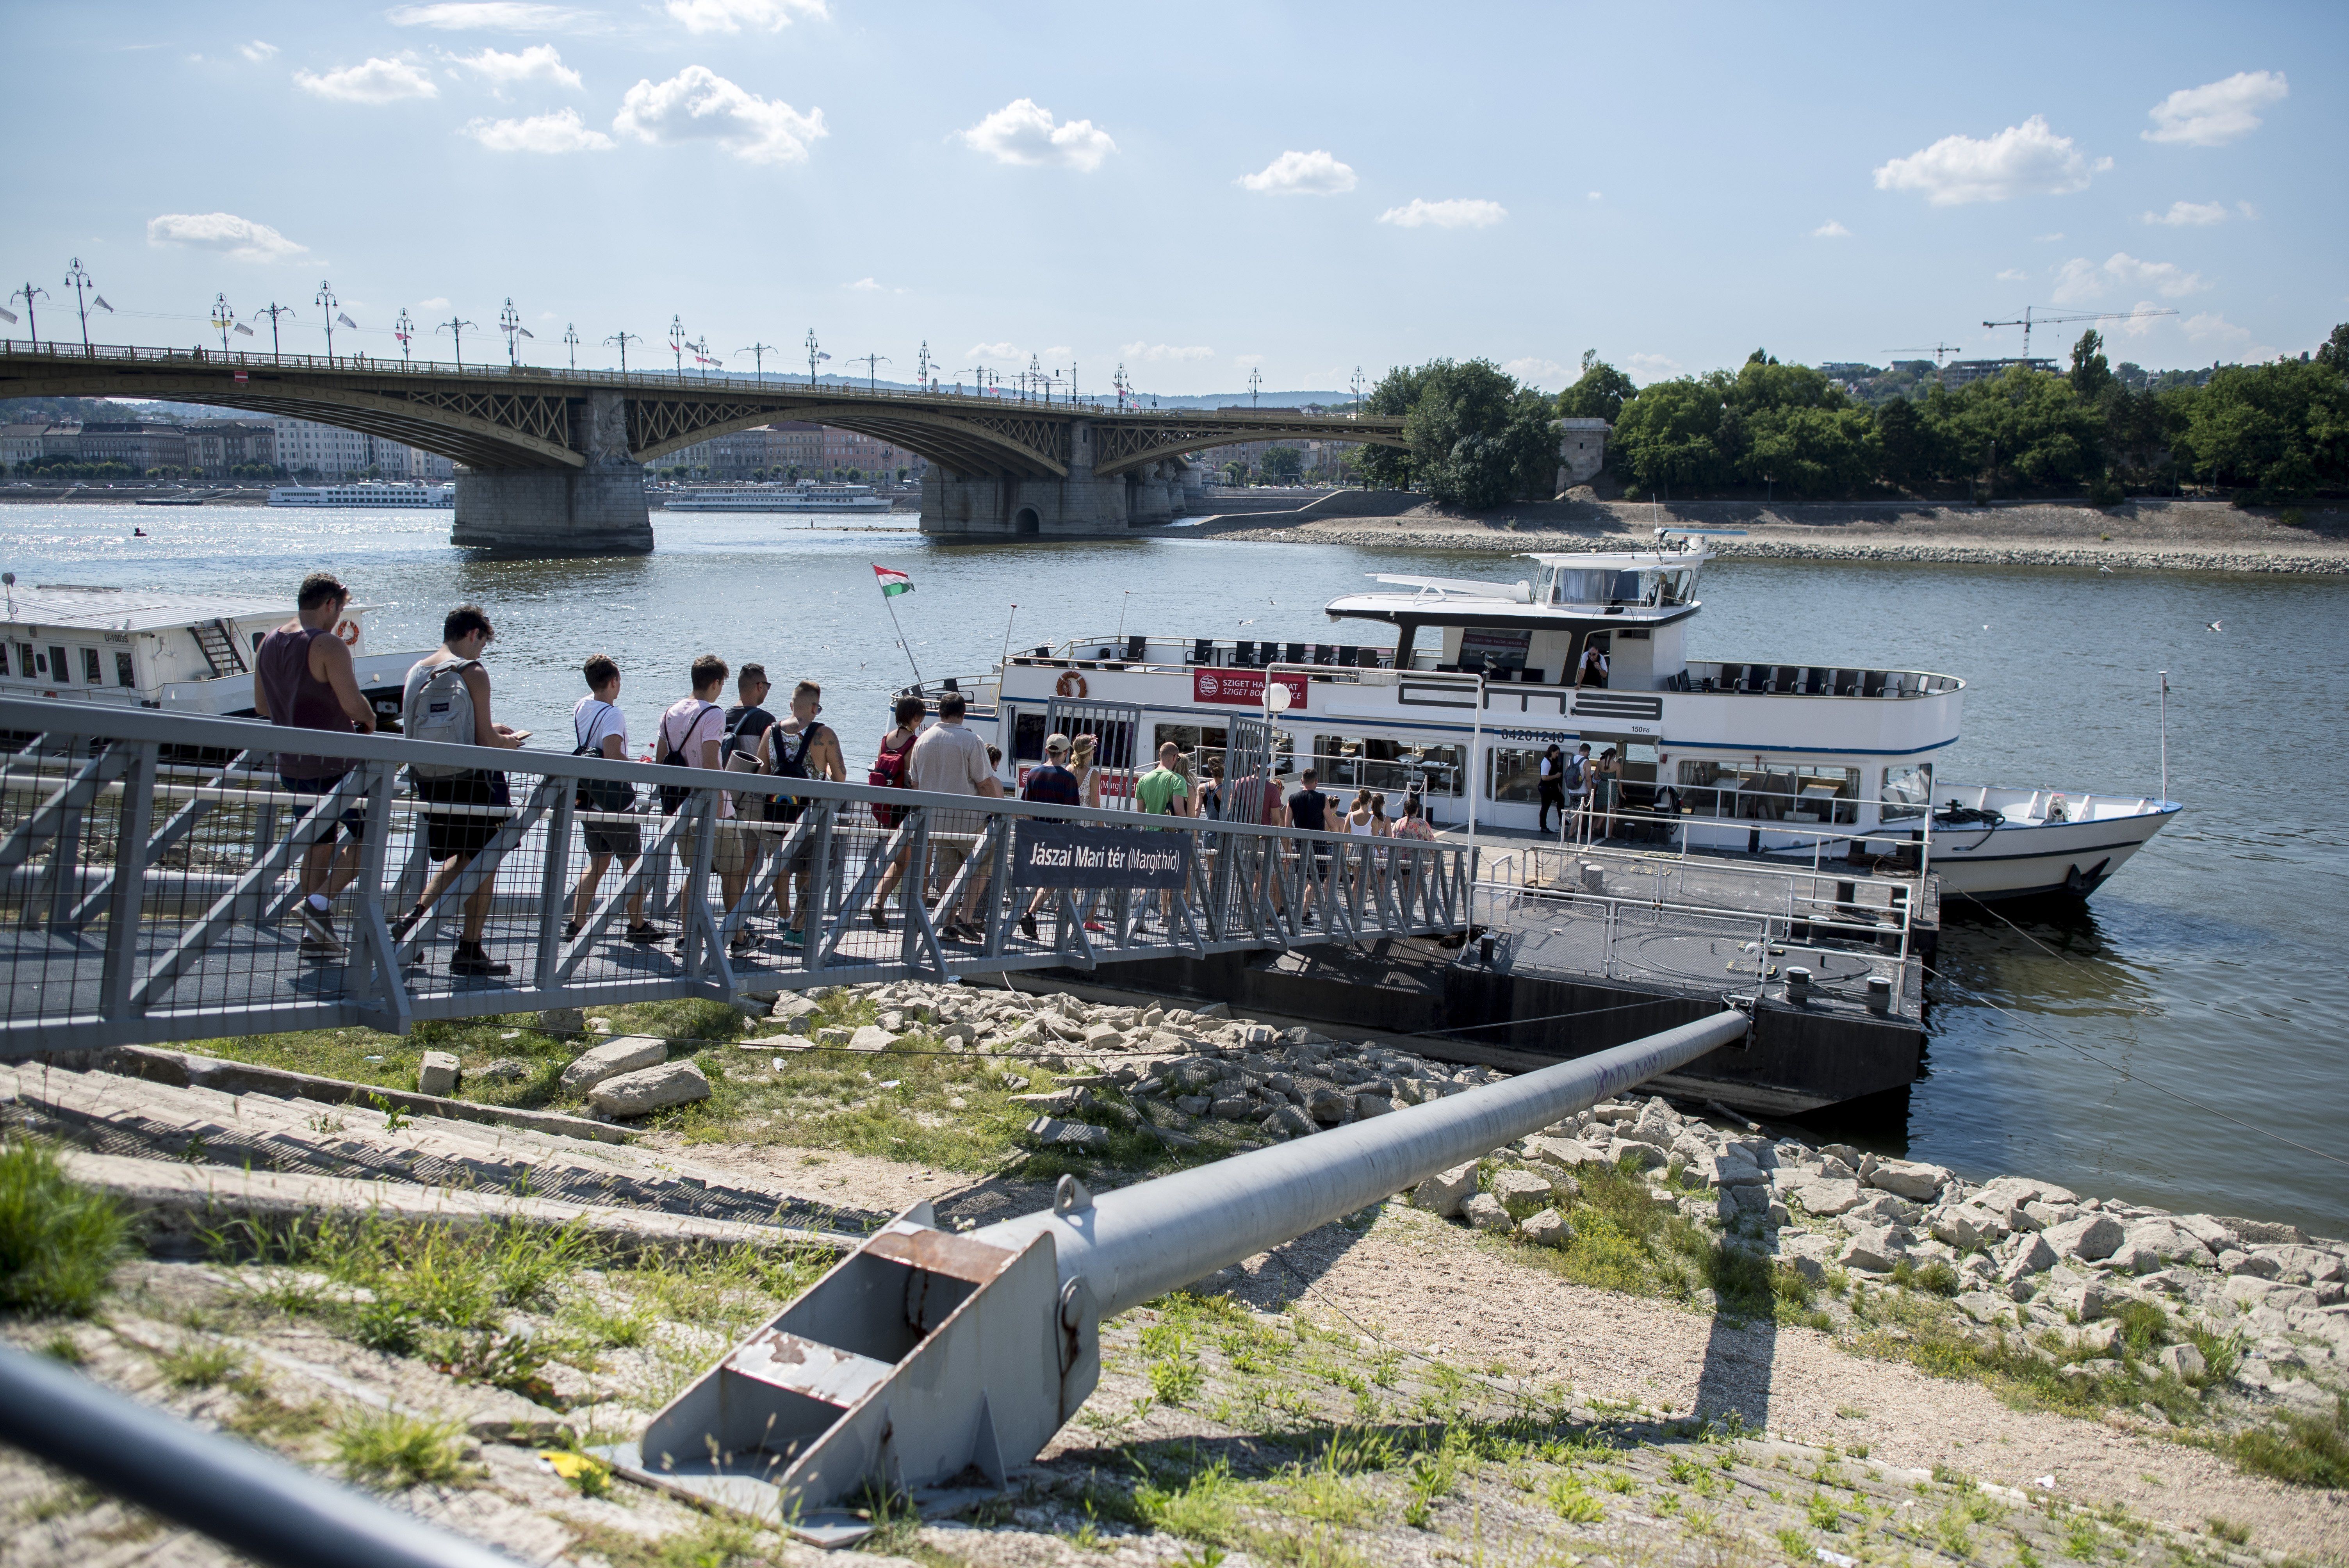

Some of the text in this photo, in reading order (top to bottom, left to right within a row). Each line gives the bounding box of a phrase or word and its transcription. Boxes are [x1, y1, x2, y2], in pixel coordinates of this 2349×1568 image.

[104, 633, 128, 643] U-10035
[1223, 679, 1250, 688] SZIGET
[1501, 729, 1565, 743] 04201240
[1030, 842, 1072, 866] Jászai
[1075, 845, 1105, 868] Mari
[1108, 846, 1125, 868] tér
